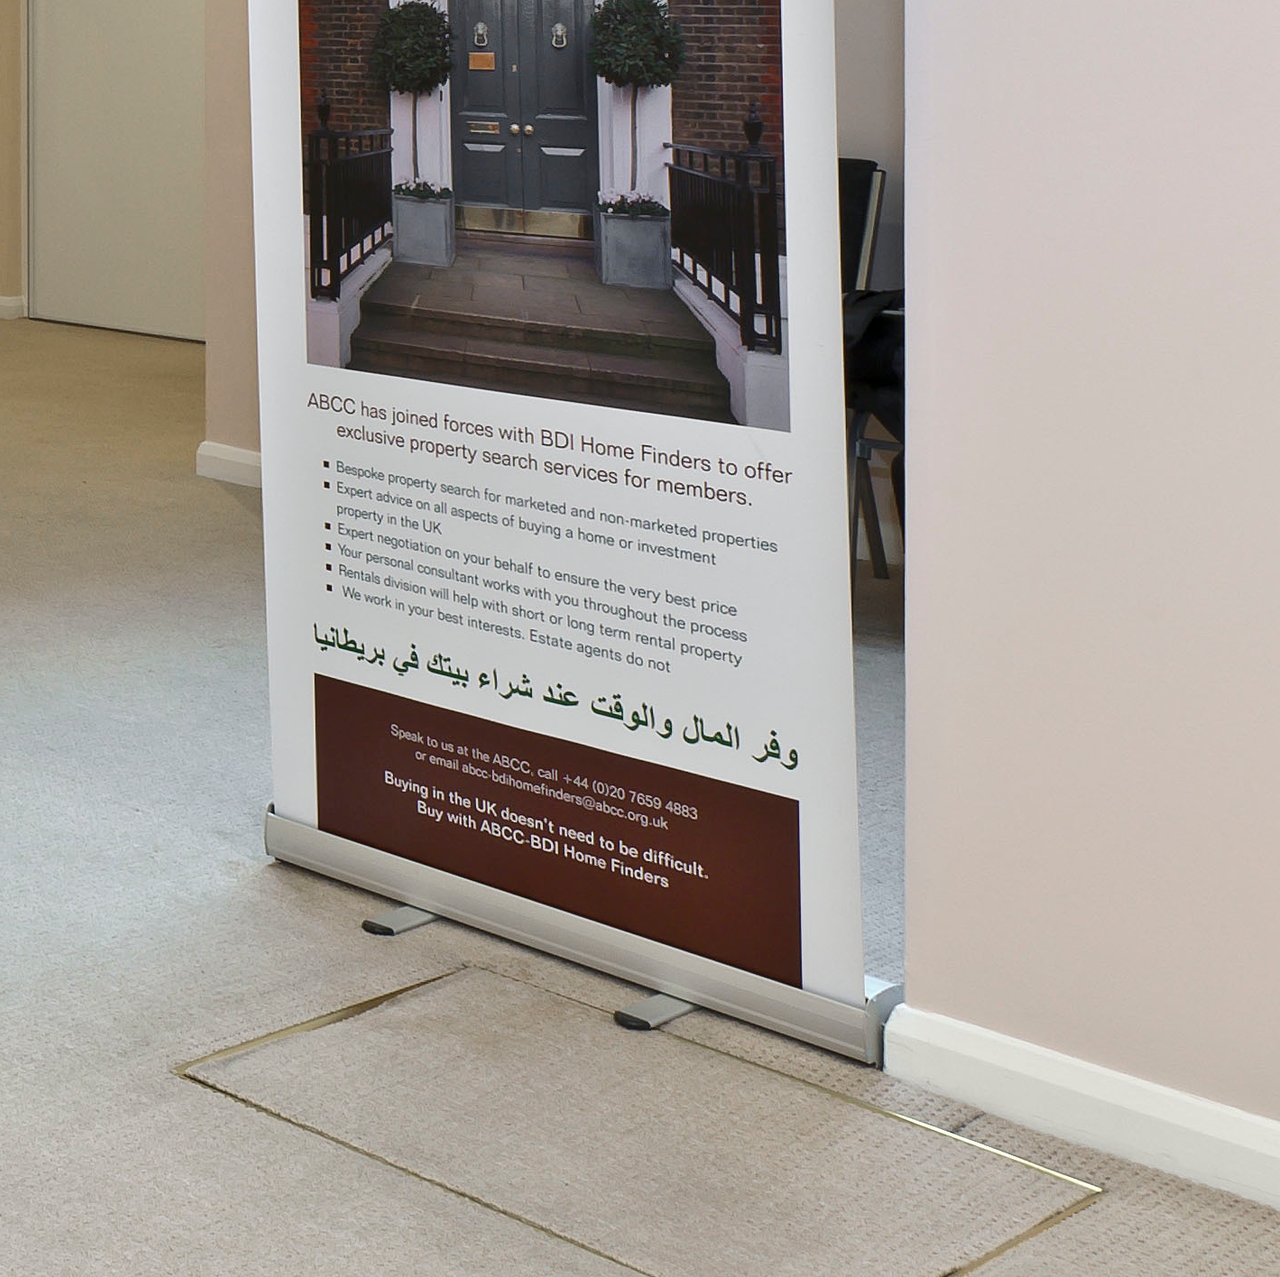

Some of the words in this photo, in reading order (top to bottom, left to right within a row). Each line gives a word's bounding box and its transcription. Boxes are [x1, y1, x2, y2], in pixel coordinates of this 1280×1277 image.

[307, 392, 355, 414] ABCC
[360, 400, 386, 420] has
[392, 407, 437, 428] joined
[443, 413, 493, 437] forces
[498, 426, 534, 444] with
[540, 429, 573, 450] BDI
[580, 435, 634, 459] Home
[641, 444, 710, 471] Finders
[718, 457, 737, 475] to
[744, 461, 792, 483] offer
[336, 425, 404, 447] exclusive
[410, 438, 476, 464] property
[482, 450, 537, 470] search
[544, 460, 617, 484] services
[624, 468, 650, 488] for
[656, 479, 751, 506] members.
[336, 460, 384, 481] Bespoke
[388, 473, 436, 493] property
[440, 483, 480, 498] search
[484, 487, 501, 502] for
[505, 495, 566, 514] marketed
[570, 507, 594, 519] and
[599, 512, 696, 537] non-marketed
[702, 530, 778, 552] properties
[337, 542, 362, 558] Your
[365, 552, 413, 570] personal
[416, 564, 479, 585] consultant
[482, 578, 520, 594] works
[523, 587, 551, 600] with
[554, 593, 578, 606] you
[583, 596, 657, 624] throughout
[662, 613, 685, 629] the
[690, 621, 747, 642] process
[313, 622, 386, 666] بريطانيا
[342, 585, 361, 600] We
[363, 594, 391, 608] work
[395, 598, 404, 611] in
[407, 604, 434, 617] your
[437, 607, 463, 625] best
[467, 615, 524, 639] interests.
[529, 628, 572, 650] Estate
[576, 643, 622, 661] agents
[626, 651, 643, 666] do
[648, 659, 670, 673] not
[392, 643, 420, 677] في
[426, 652, 470, 688] بيتك
[477, 668, 534, 700] شراء
[542, 683, 580, 707] عند
[414, 751, 426, 760] or
[428, 755, 458, 770] email
[682, 714, 741, 750] المال
[751, 729, 799, 770] وفر
[390, 723, 424, 744] Speak
[426, 735, 438, 748] to
[440, 741, 454, 752] us
[456, 745, 468, 756] at
[471, 748, 490, 762] the
[537, 768, 557, 781] call
[562, 774, 588, 789] +44
[628, 790, 661, 809] 7659
[664, 800, 697, 819] 4883
[384, 770, 428, 799] Buying
[432, 785, 444, 800] in
[448, 791, 470, 808] the
[475, 797, 497, 816] UK
[500, 807, 554, 833] doesn't
[558, 826, 594, 845] need
[599, 835, 614, 851] to
[618, 839, 638, 857] be
[642, 848, 708, 879] difficult.
[417, 799, 443, 821] Buy
[446, 812, 476, 829] with
[480, 819, 558, 854] ABCC-BDI
[564, 843, 606, 869] Home
[611, 858, 668, 887] Finders
